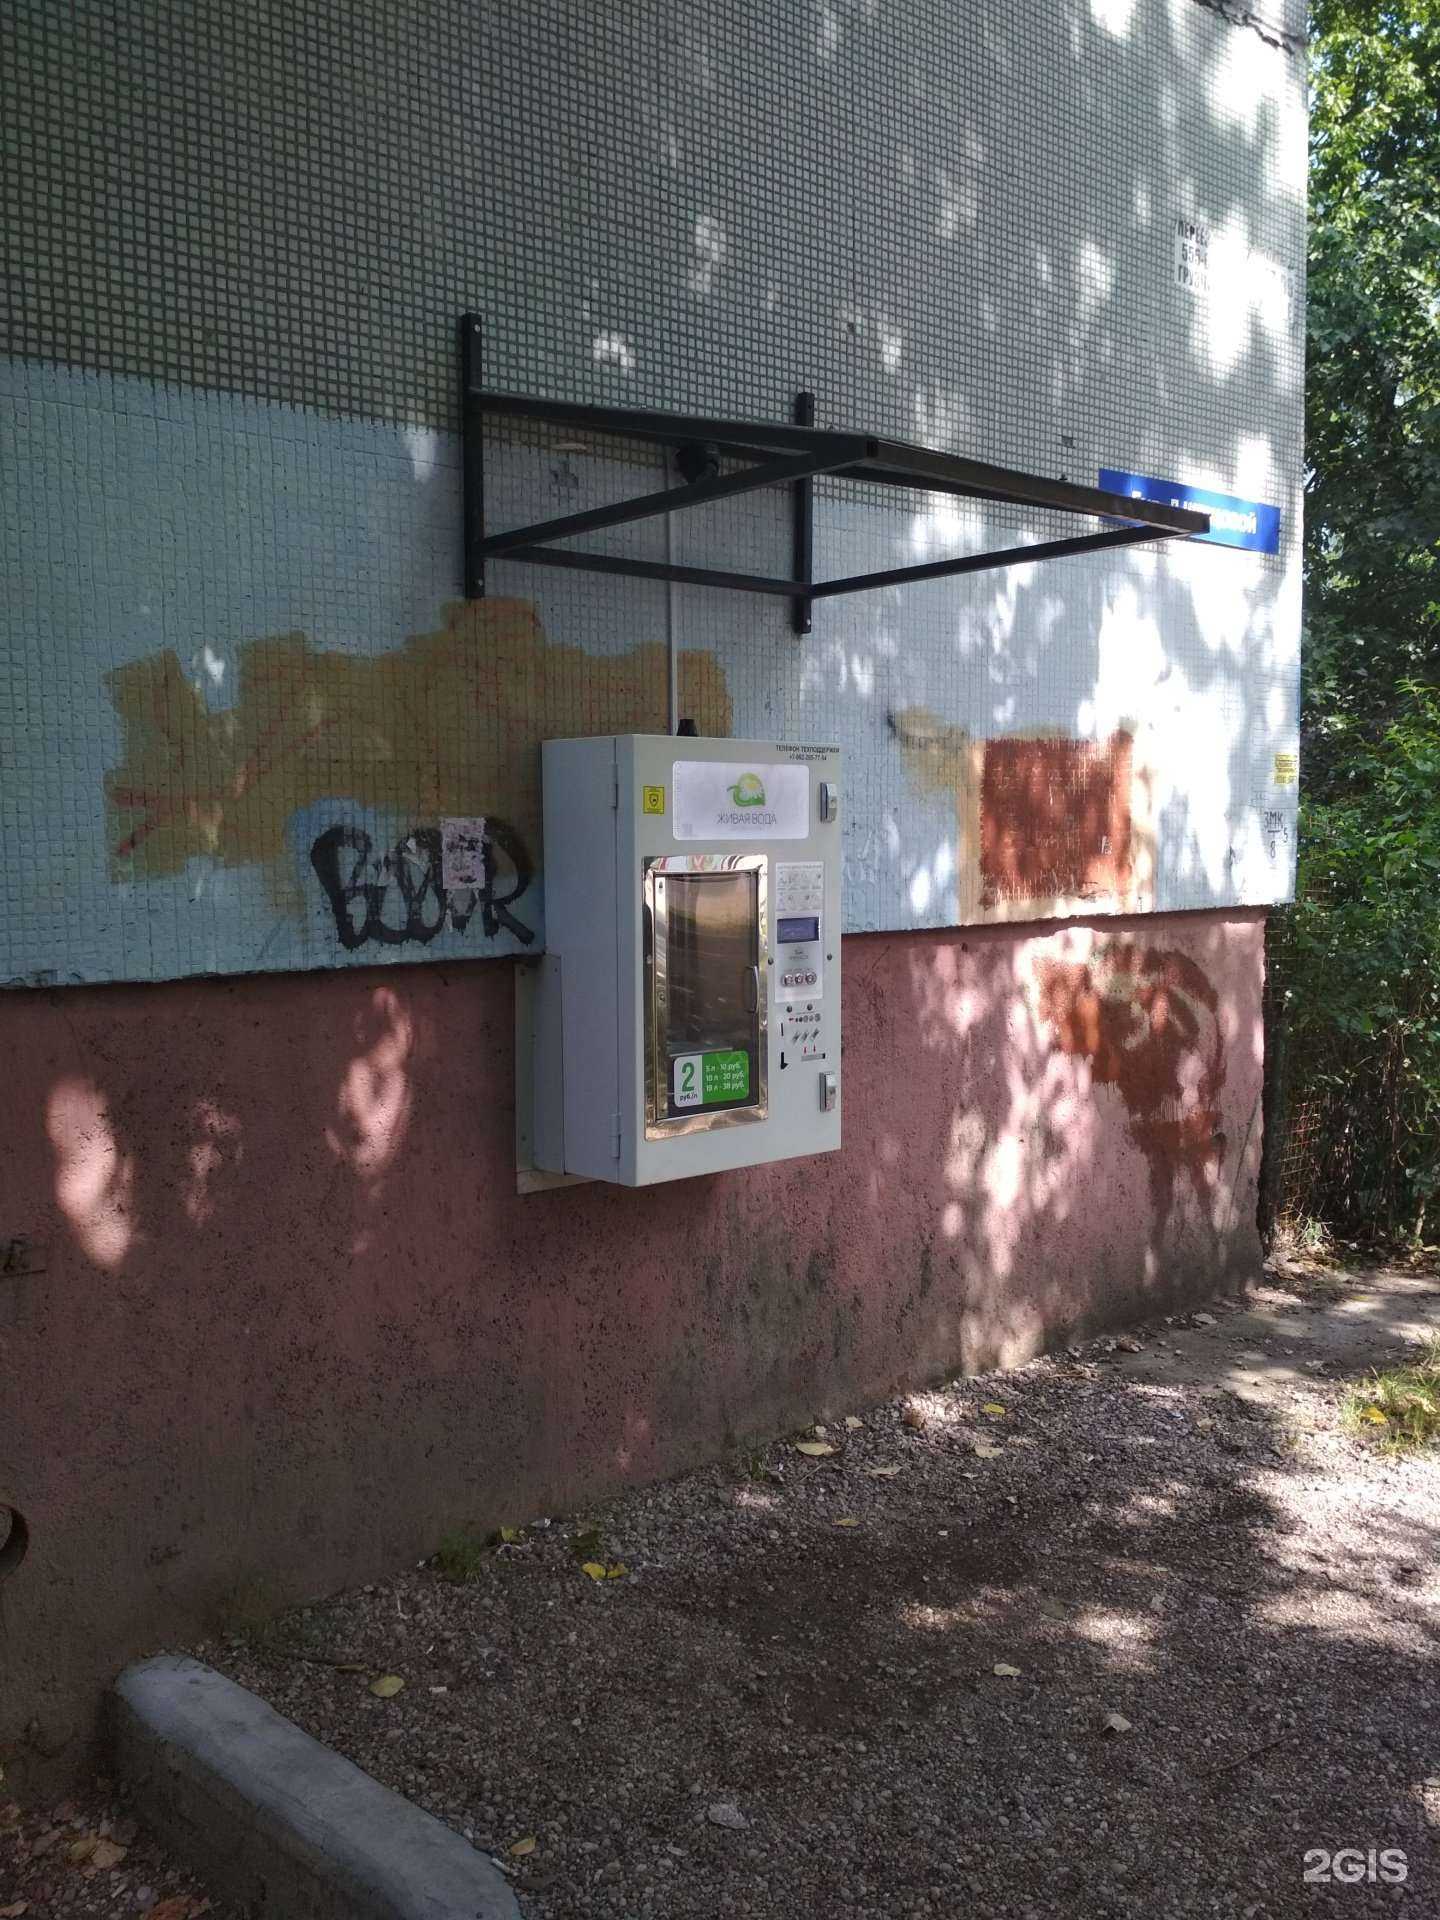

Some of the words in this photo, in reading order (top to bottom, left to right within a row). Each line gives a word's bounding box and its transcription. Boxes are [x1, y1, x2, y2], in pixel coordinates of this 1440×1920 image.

[716, 813, 751, 824] ЖИВАЯ
[751, 813, 776, 824] ВОДА
[681, 1062, 695, 1092] 2
